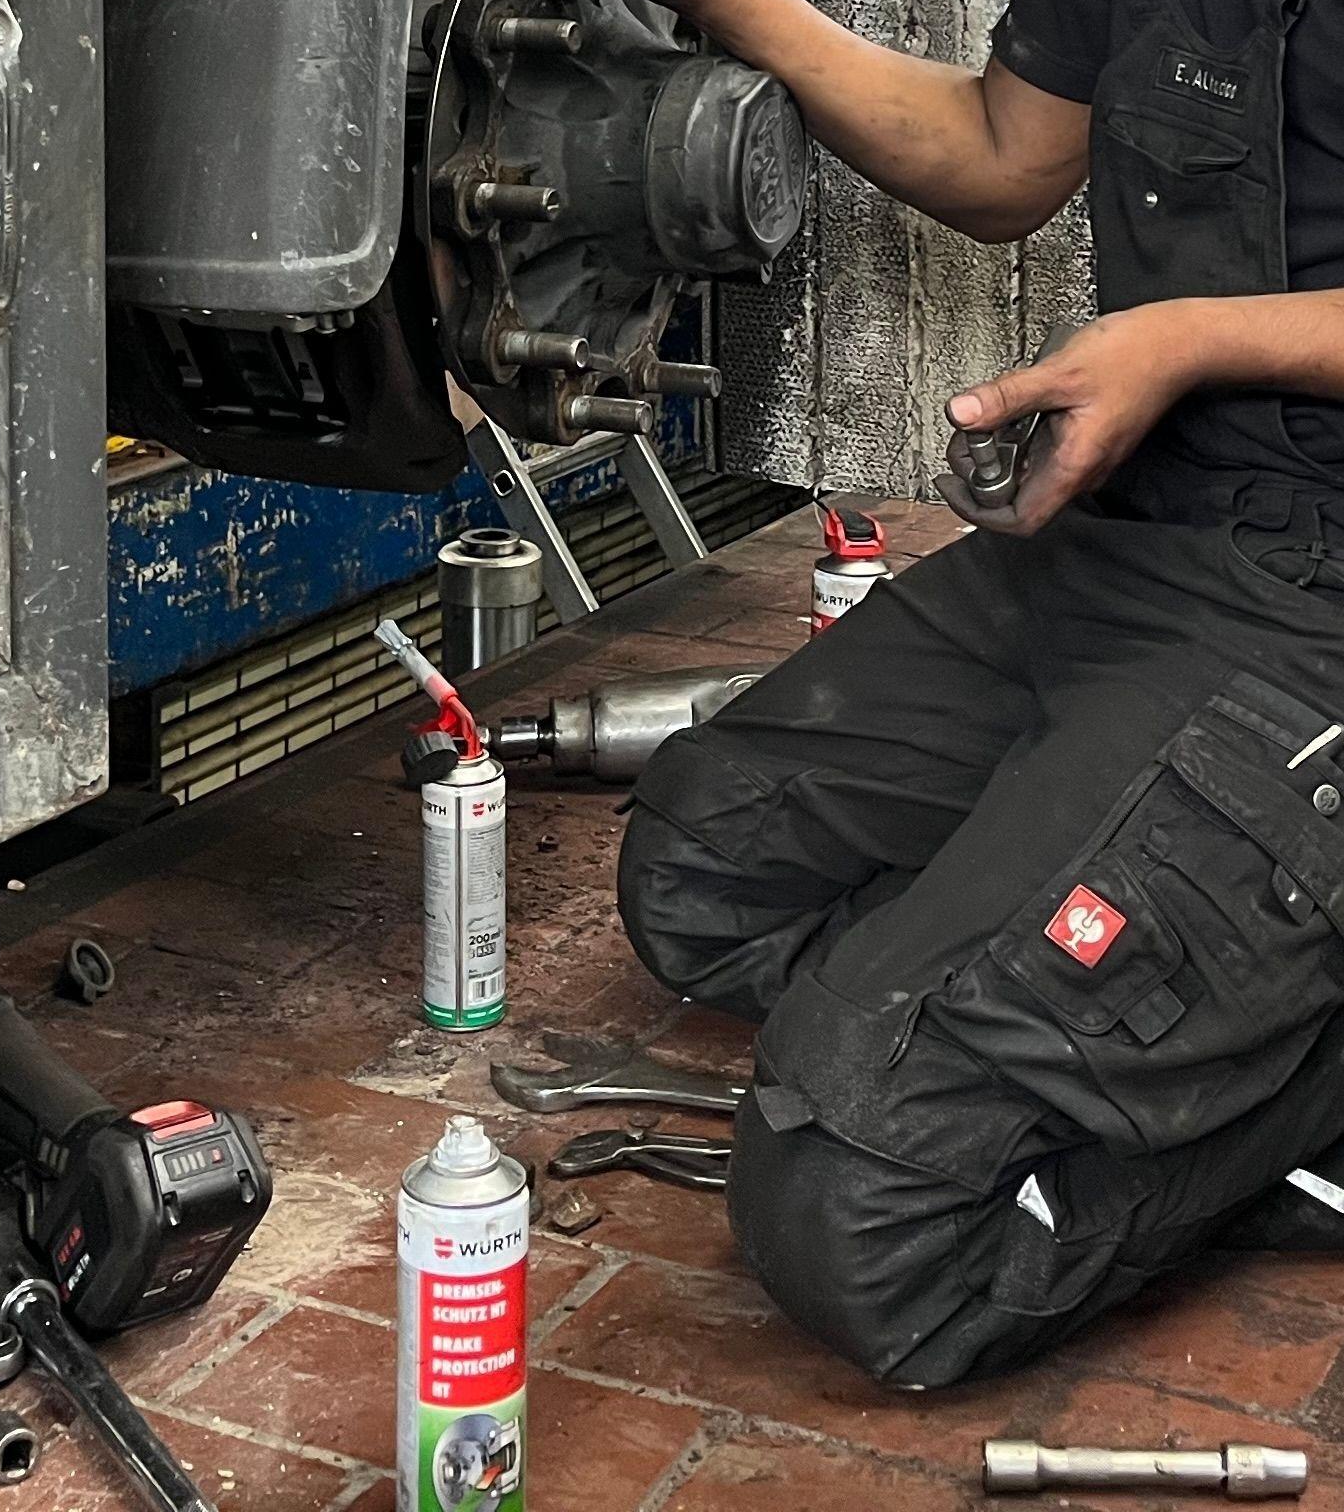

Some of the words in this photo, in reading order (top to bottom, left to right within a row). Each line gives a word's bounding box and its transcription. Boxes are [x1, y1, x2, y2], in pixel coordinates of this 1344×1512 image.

[468, 933, 490, 945] 200
[432, 1279, 506, 1299] BREMSEN-
[432, 1305, 487, 1323] SCHUTZ
[432, 1335, 482, 1352] BRAKE
[432, 1348, 516, 1376] PROTECTION
